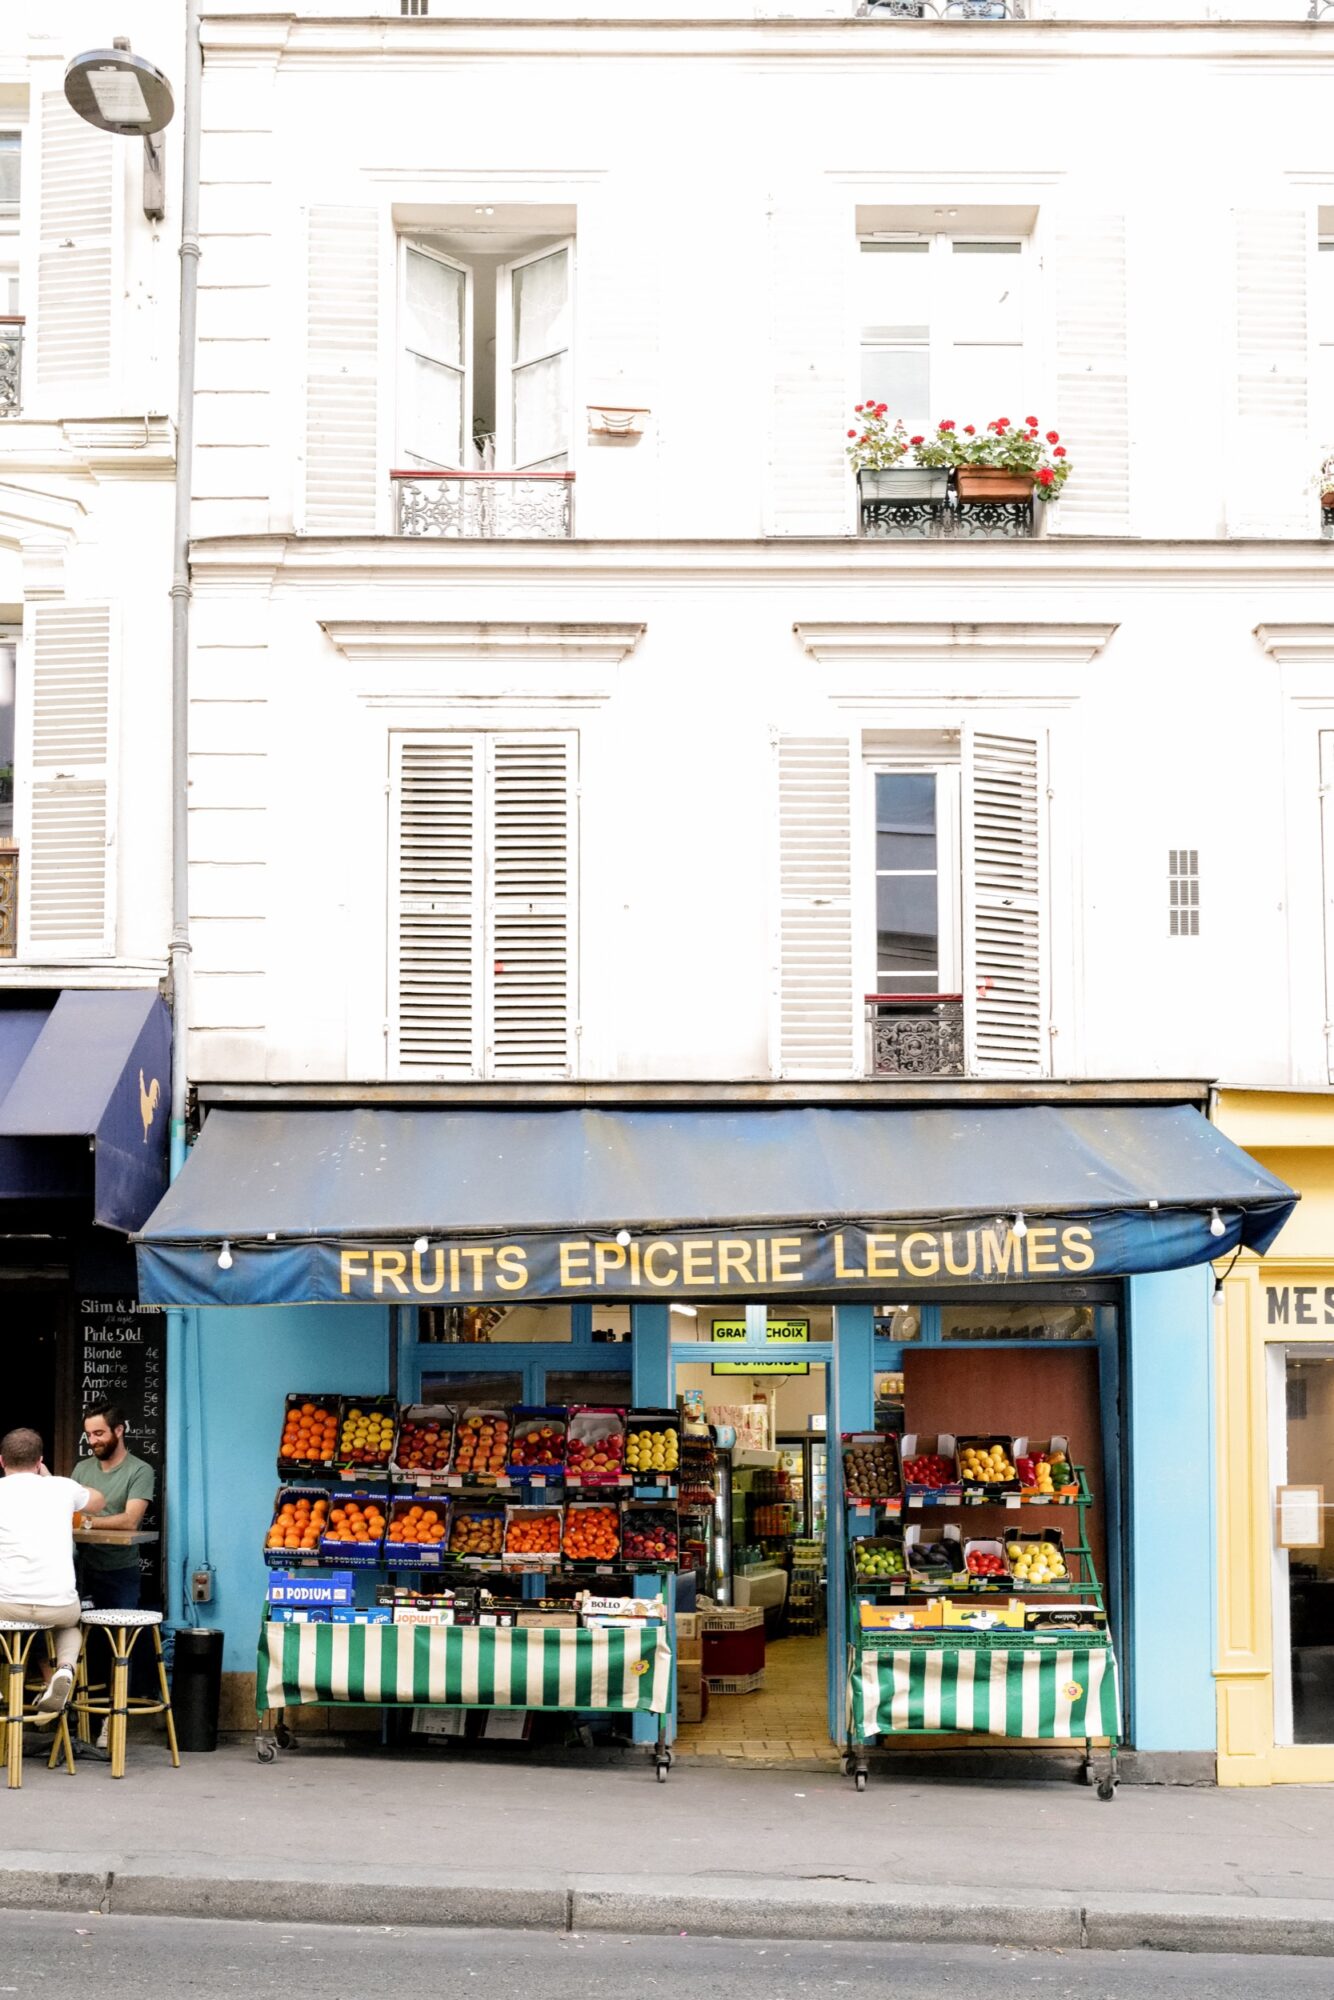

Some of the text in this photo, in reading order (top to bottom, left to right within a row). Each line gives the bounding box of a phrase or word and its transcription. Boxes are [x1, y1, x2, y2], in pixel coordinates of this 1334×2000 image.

[340, 1226, 1095, 1294] FRUITS EPICERIE LEGUMES
[80, 1299, 114, 1314] Slim
[116, 1299, 127, 1314] &
[716, 1327, 804, 1338] GRA CHOIX
[83, 1346, 160, 1360] Blonde 4€
[83, 1360, 160, 1374] Blanche 5€
[81, 1375, 160, 1389] Ambrée 5€
[143, 1391, 158, 1403] 5€
[143, 1405, 158, 1417] 5€
[143, 1441, 159, 1454] 5€
[405, 1471, 446, 1481] Lior
[286, 1587, 331, 1600] PODIUM
[590, 1600, 621, 1609] BOLLO
[396, 1614, 439, 1625] Limdor
